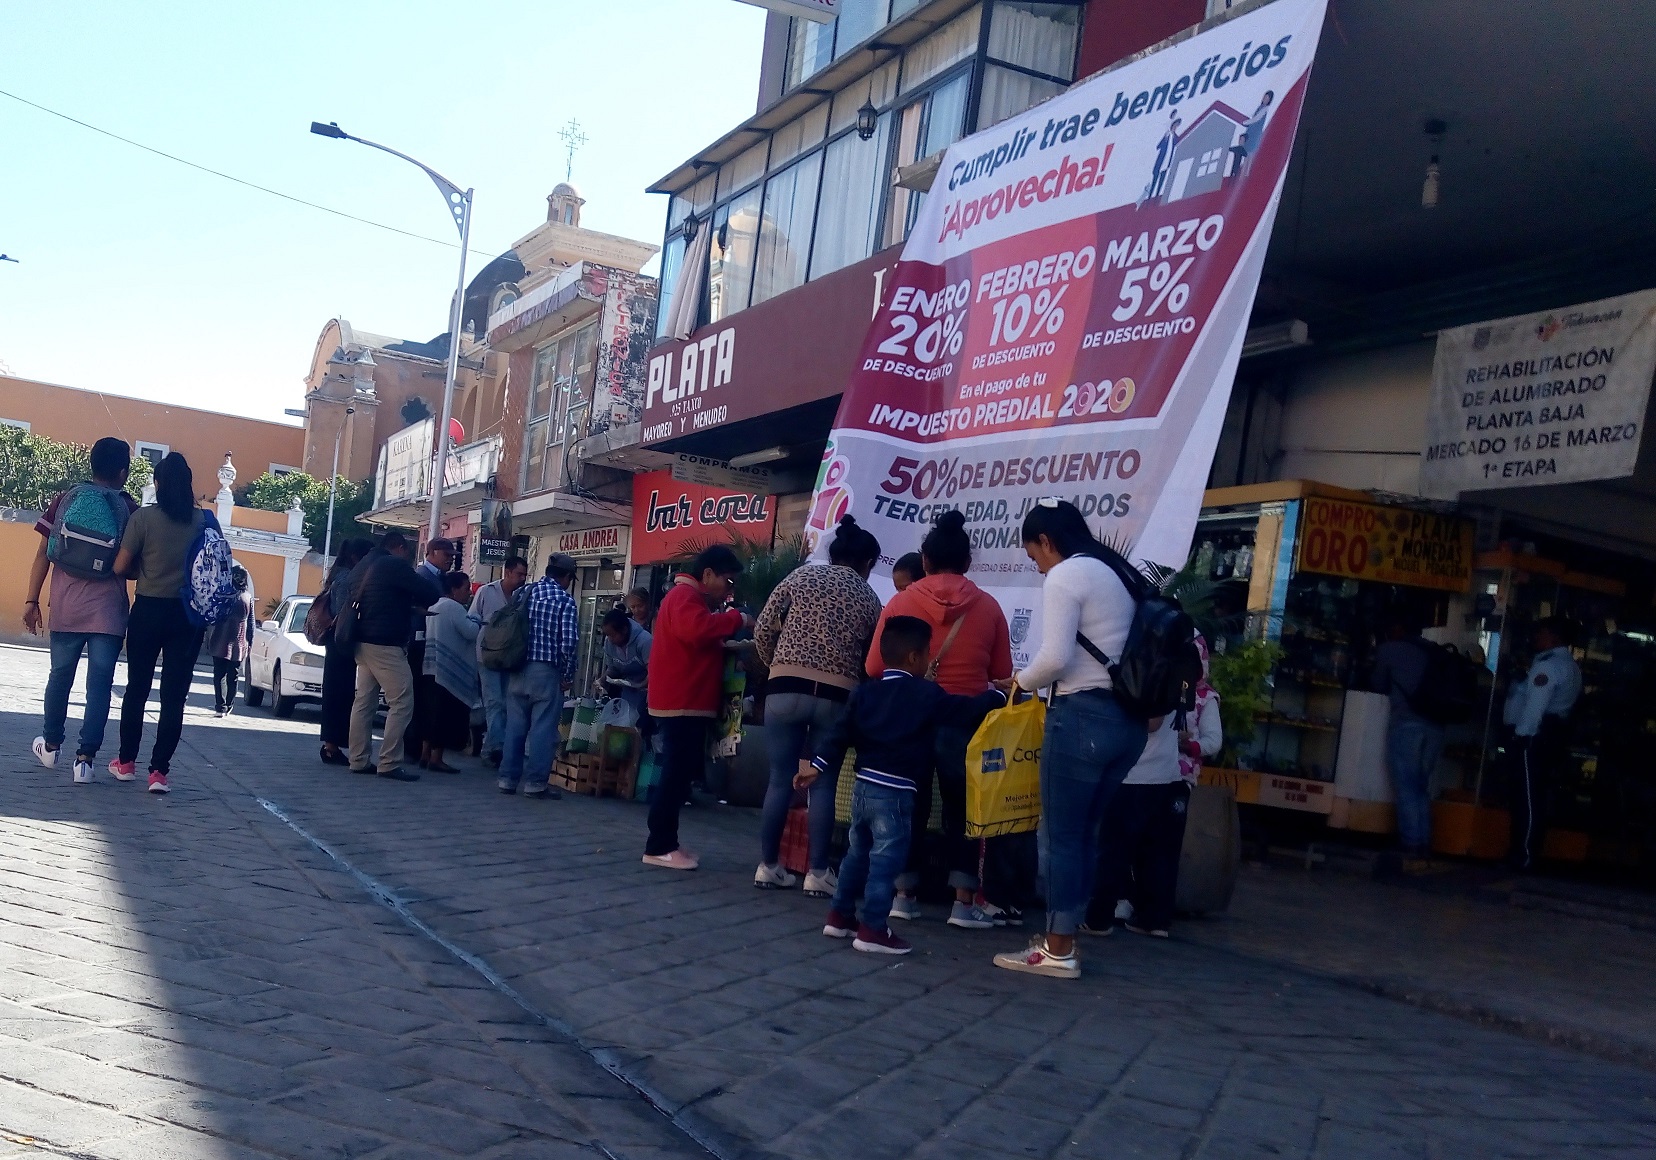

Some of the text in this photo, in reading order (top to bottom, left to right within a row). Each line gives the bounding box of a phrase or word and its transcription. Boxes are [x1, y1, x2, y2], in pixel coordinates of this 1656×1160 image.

[948, 34, 1292, 191] Cumplir trae beneficios
[938, 143, 1115, 243] ¡Aprovecha!
[1101, 214, 1225, 273] MARZO
[976, 245, 1096, 303] FEBRERO
[1111, 257, 1197, 322] 5%
[889, 278, 971, 323] ENERO
[988, 284, 1070, 347] 10%
[876, 308, 968, 364] 20%
[1083, 316, 1196, 349] DE DESCUENTO
[645, 327, 735, 409] PLATA
[862, 358, 953, 383] DE DESCUENTO
[972, 341, 1055, 370] DE DESCUENTO
[1466, 346, 1614, 385] REHABILITACIÓN
[959, 371, 1047, 400] En el pago de tu
[1461, 374, 1606, 408] DE ALUMBRADO
[643, 404, 728, 443] MAYOREO Y MENUDEO
[868, 376, 1136, 437] IMPUESTO PREDIAL 2020
[1466, 403, 1585, 431] PLANTA BAJA
[1426, 423, 1637, 462] MERCADO 16 DE MARZO
[879, 449, 1140, 501] 50% DE DESCUENTO
[1502, 458, 1556, 478] ETAPA
[646, 489, 770, 533] bar coca
[964, 500, 1010, 525] EDAD,
[1014, 493, 1132, 521] JUADOS
[1308, 501, 1375, 533] COMPRO
[481, 538, 511, 547] MAESTRO
[559, 529, 618, 551] CASA ANDREA
[1305, 528, 1369, 575] ORO
[998, 563, 1012, 572] SEA
